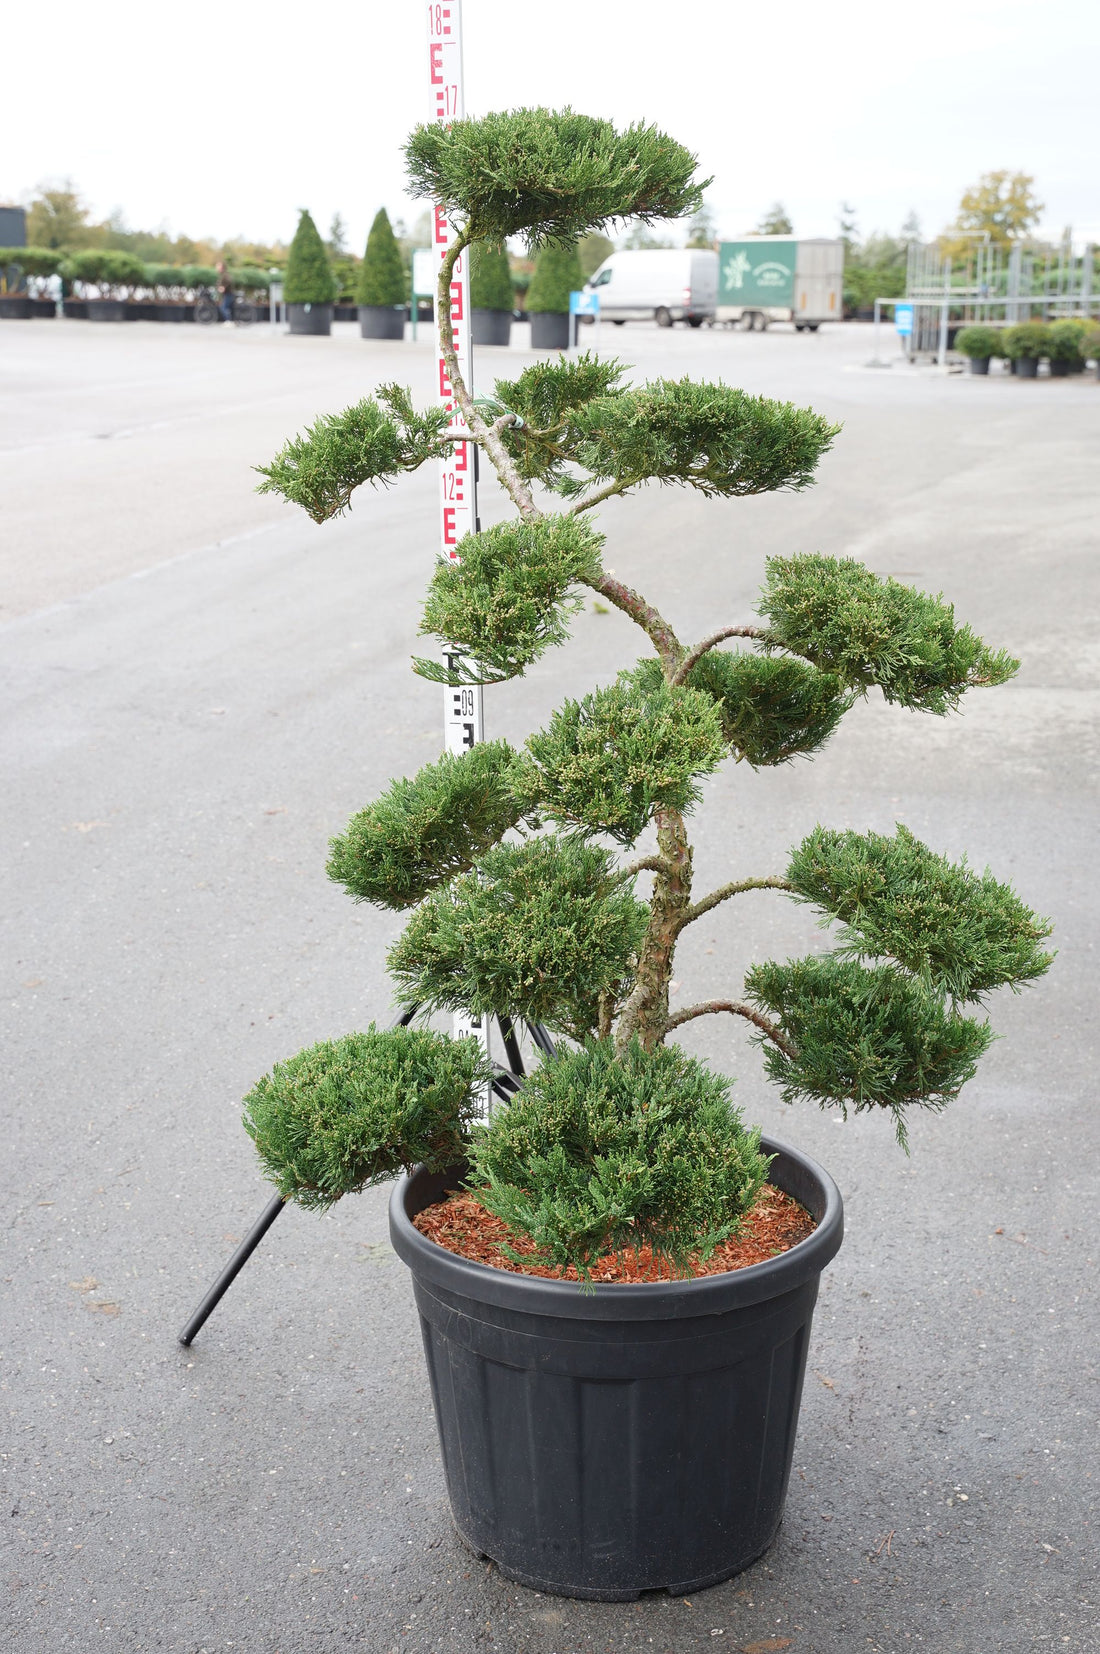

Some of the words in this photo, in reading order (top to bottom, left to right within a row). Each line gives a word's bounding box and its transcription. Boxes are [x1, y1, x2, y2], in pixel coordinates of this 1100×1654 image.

[428, 4, 442, 36] 18
[445, 85, 458, 116] 17
[442, 472, 455, 501] 12
[461, 689, 474, 717] 09
